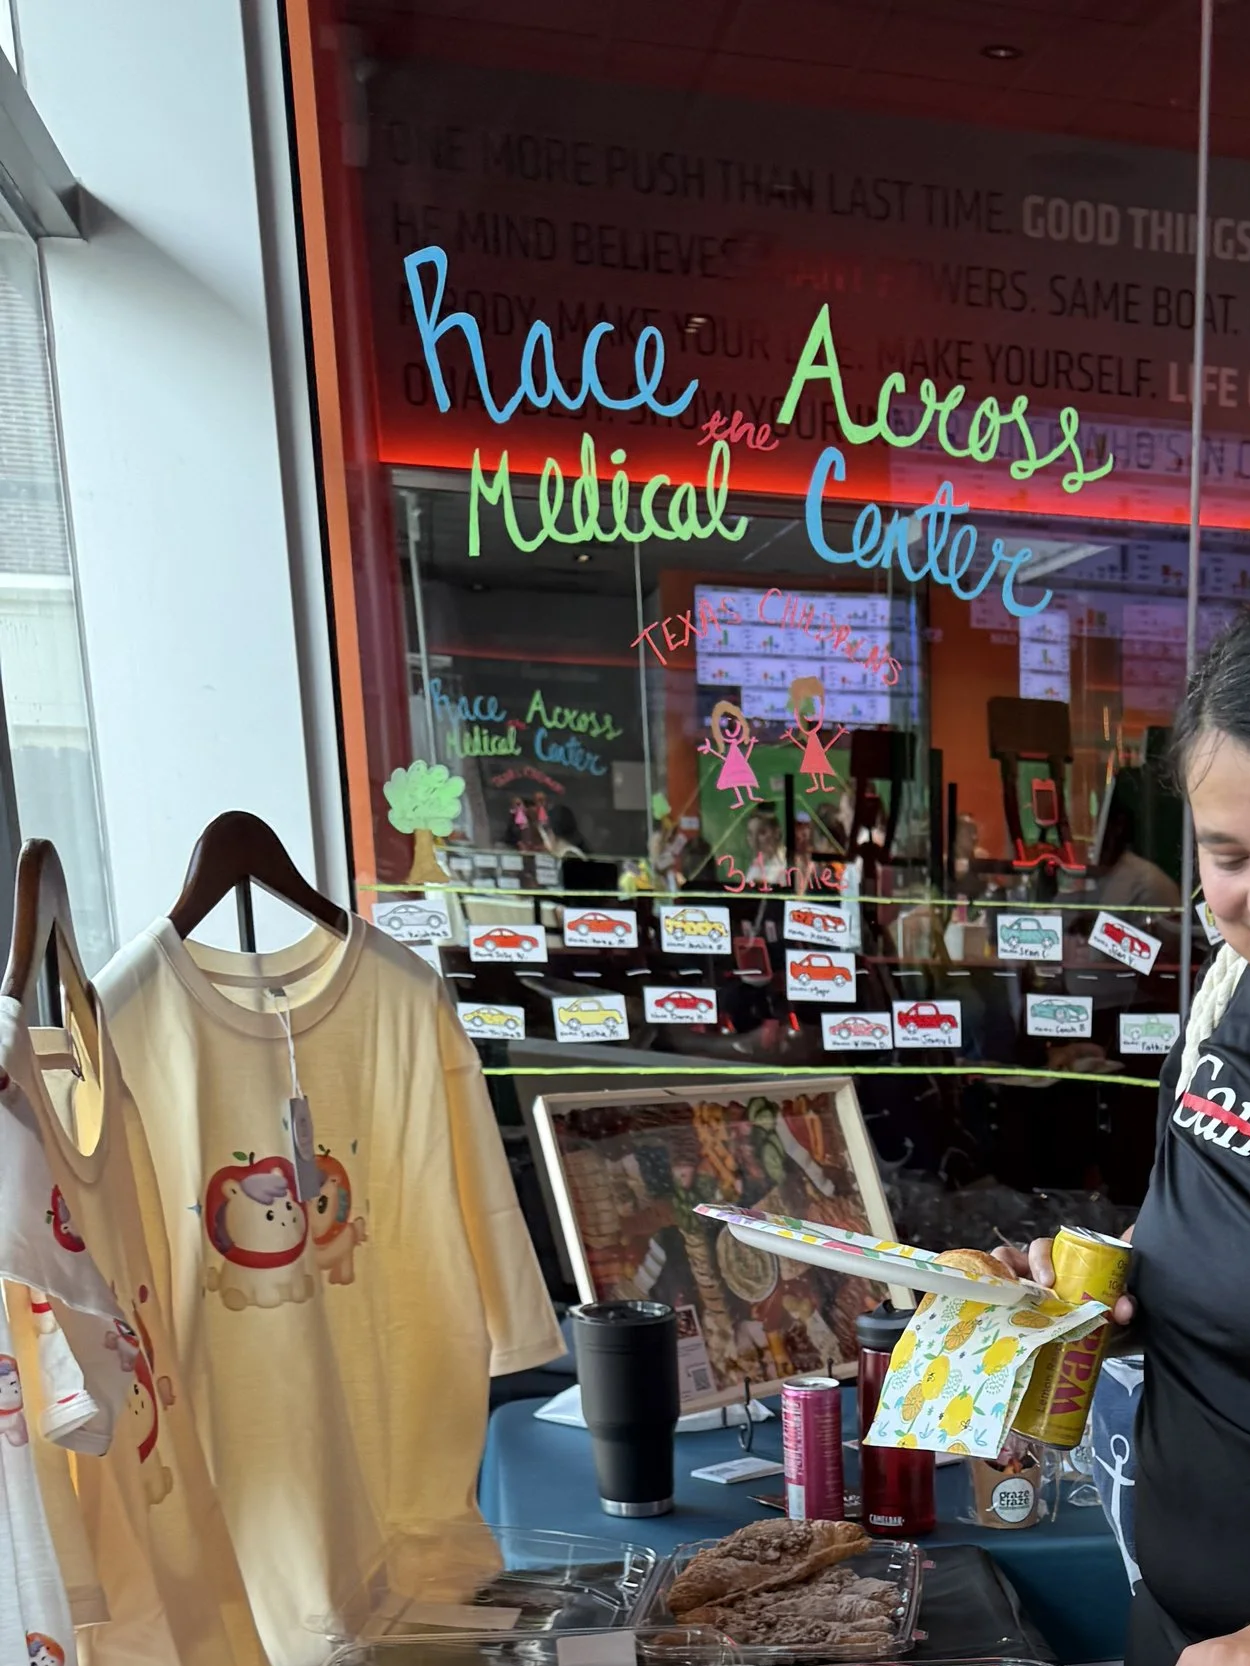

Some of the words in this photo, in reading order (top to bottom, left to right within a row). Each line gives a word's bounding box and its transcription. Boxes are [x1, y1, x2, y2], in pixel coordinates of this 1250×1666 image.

[480, 132, 594, 188] MORE
[604, 144, 705, 200] PUSH
[716, 157, 814, 207] THAN
[826, 170, 914, 224] LAST
[919, 182, 1013, 237] TIME.
[1020, 193, 1121, 249] GOOD
[456, 210, 560, 263] MIND
[1046, 273, 1141, 325] SAME
[1152, 286, 1241, 337] BOAT.
[403, 245, 700, 424] Race
[777, 302, 1113, 496] Across
[984, 342, 1158, 403] YOURSELF.
[696, 409, 779, 452] the
[468, 432, 748, 558] Medical
[804, 446, 1053, 619] Center
[631, 596, 742, 667] TEXAS
[524, 689, 624, 742] Across
[533, 731, 609, 777] Center
[999, 1489, 1029, 1501] graze
[1000, 1497, 1029, 1506] craze
